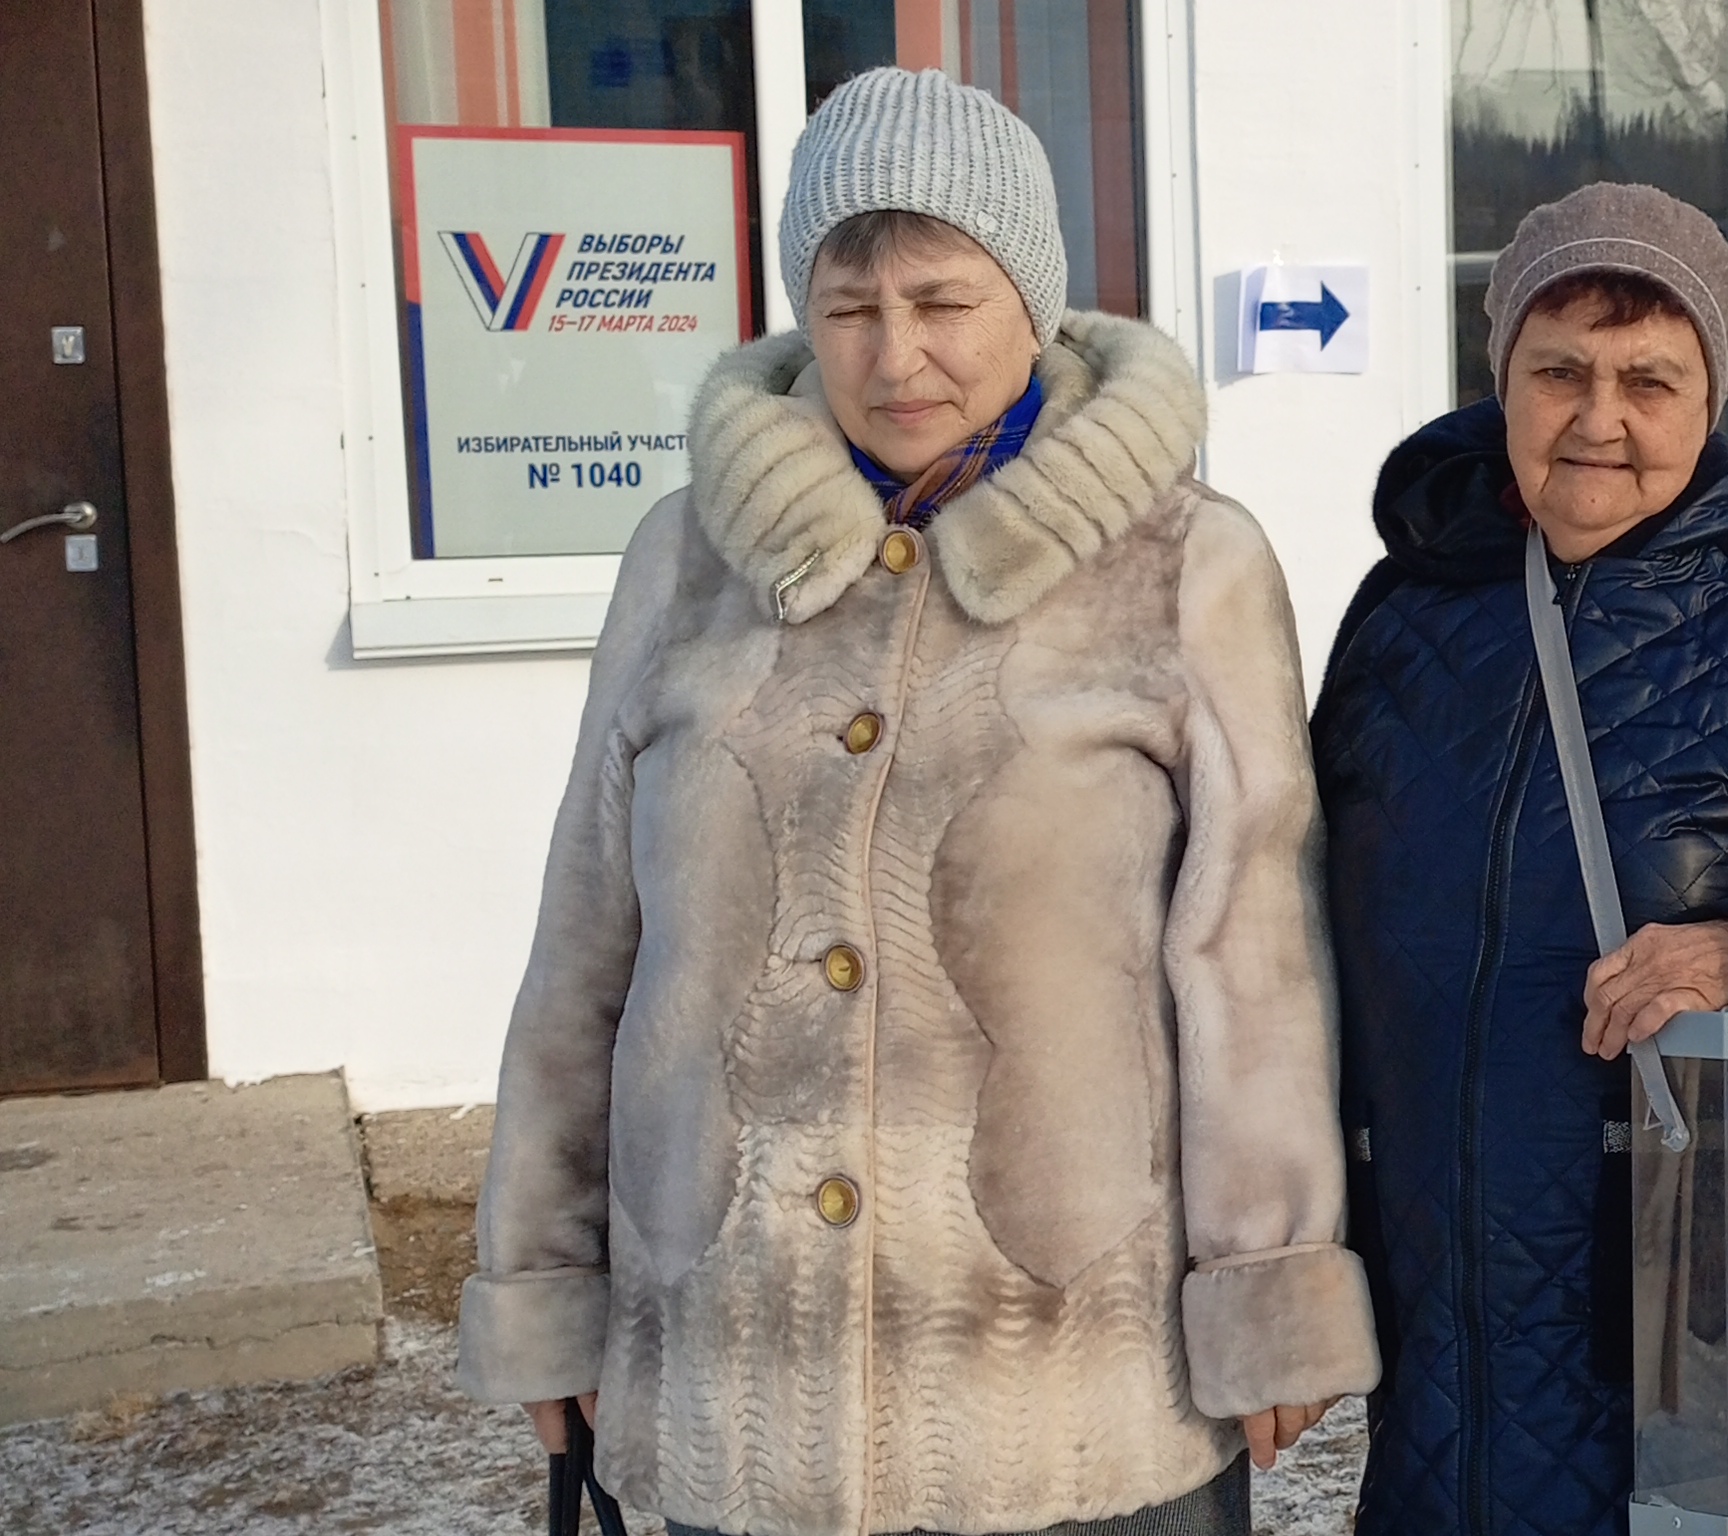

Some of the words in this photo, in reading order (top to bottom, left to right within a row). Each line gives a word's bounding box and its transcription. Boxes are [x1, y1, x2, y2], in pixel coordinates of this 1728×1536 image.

[577, 233, 685, 255] ВЫБОРЫ
[566, 260, 717, 285] ПРЕЗИДЕНТА
[555, 288, 653, 309] РОССИИ
[596, 314, 655, 332] МАРТА
[656, 314, 698, 332] 2024
[457, 431, 622, 453] ИЗБИРАТЕЛЬНЫЙ
[627, 434, 689, 452] УЧАСТ
[528, 462, 560, 489] №
[571, 461, 641, 488] 1040
